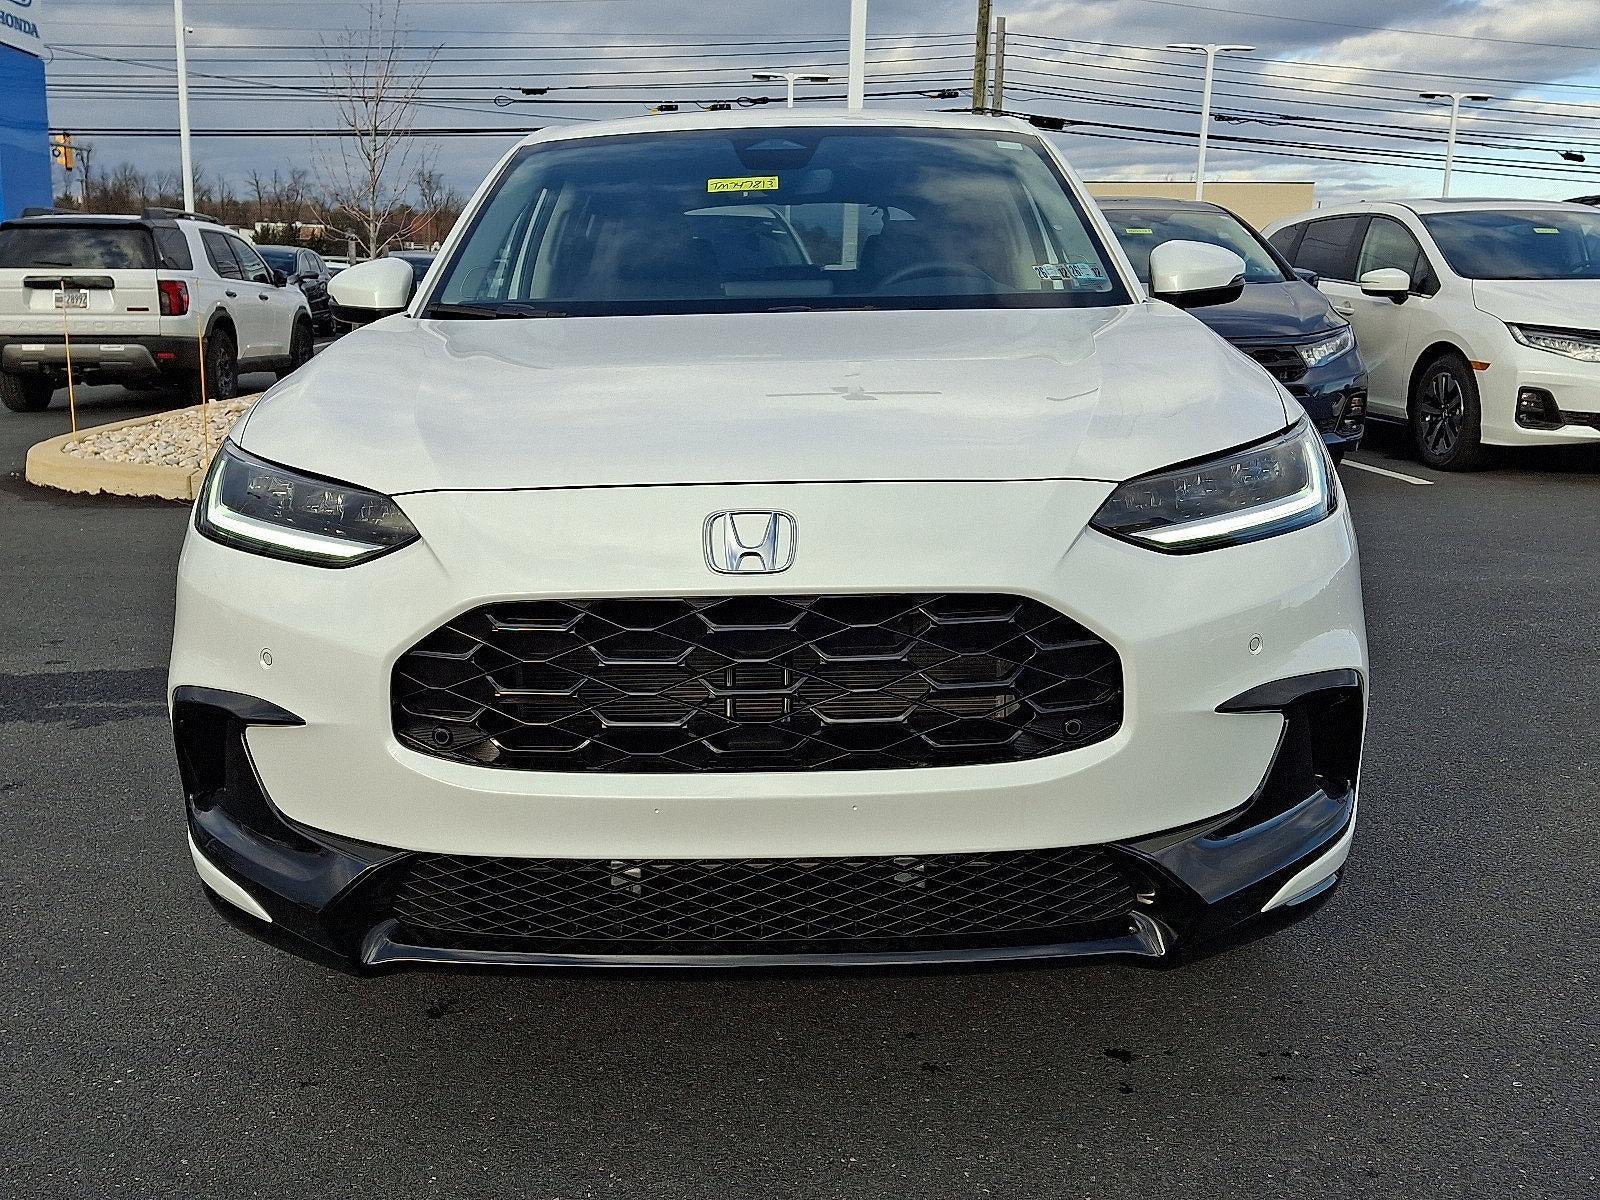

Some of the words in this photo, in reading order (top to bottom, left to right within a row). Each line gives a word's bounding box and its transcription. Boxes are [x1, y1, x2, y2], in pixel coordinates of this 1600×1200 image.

[1034, 266, 1049, 279] 26
[1058, 267, 1071, 279] 12
[1091, 267, 1104, 278] 12
